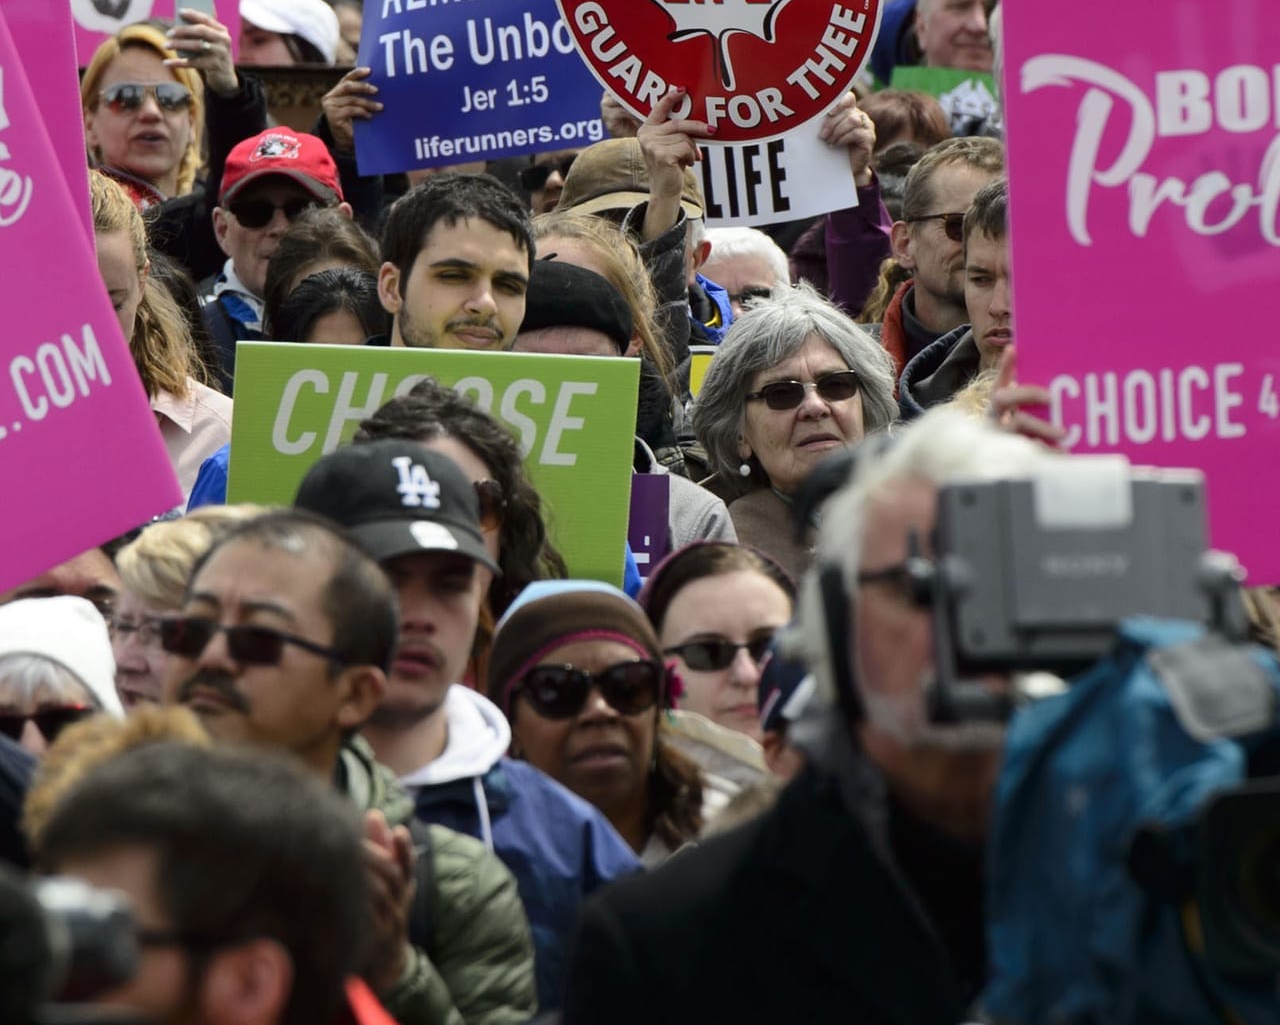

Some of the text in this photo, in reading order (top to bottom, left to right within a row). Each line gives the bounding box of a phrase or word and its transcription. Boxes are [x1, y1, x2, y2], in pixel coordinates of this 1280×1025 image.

[378, 11, 577, 78] The Unbo
[705, 87, 796, 131] FOR
[785, 3, 868, 102] THEE
[460, 75, 550, 114] Jer 1:5
[414, 118, 604, 160] liferunners.org
[699, 138, 792, 219] LIFE
[391, 456, 442, 509] LA
